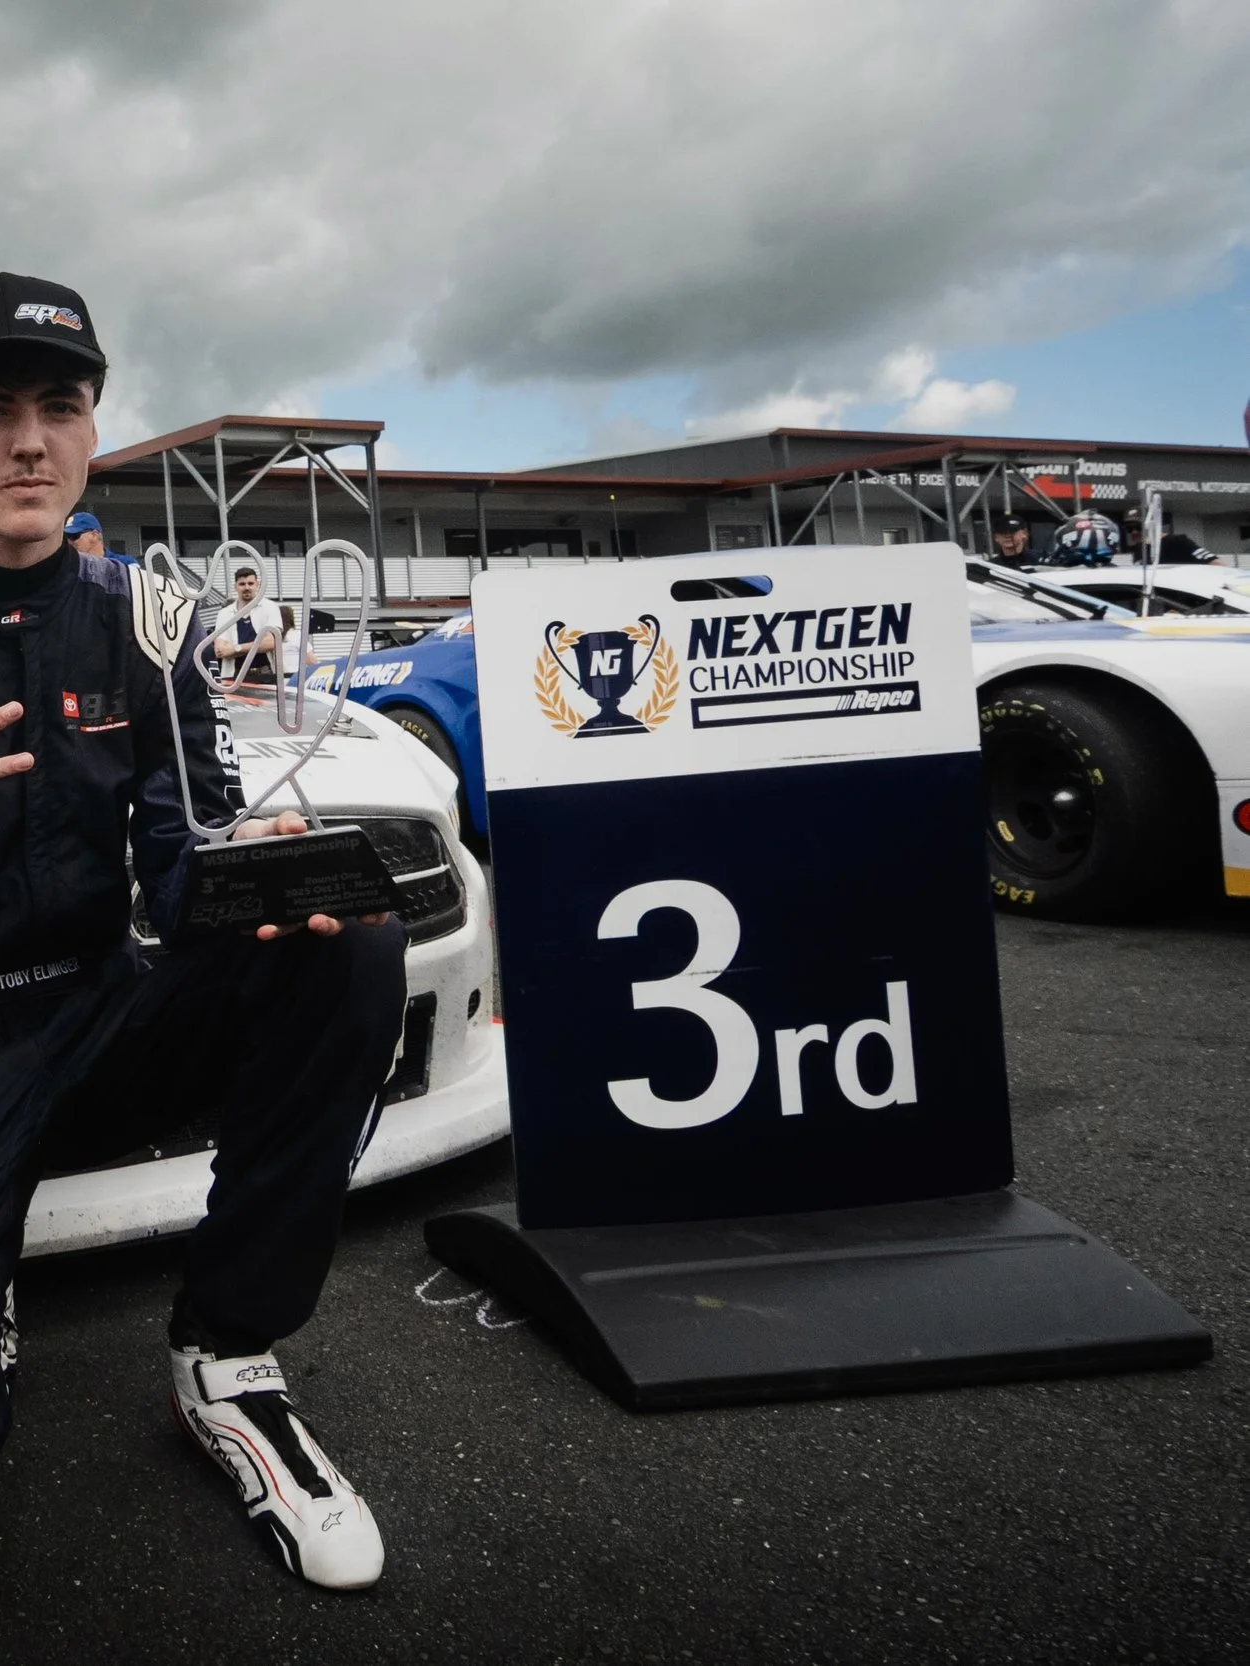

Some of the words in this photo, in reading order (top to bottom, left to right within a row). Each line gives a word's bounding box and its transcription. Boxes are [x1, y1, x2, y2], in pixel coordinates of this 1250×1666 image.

[686, 602, 913, 661] NEXTGEN
[589, 648, 625, 677] NG
[689, 651, 916, 693] CHAMPIONSHIP
[851, 688, 916, 711] Repco
[401, 719, 430, 741] EAGLE
[203, 851, 247, 867] MSNZ
[250, 837, 361, 861] Championship
[228, 882, 256, 892] Place
[304, 873, 338, 885] Round
[340, 872, 362, 881] One
[284, 887, 311, 898] 2025
[313, 884, 332, 894] Oct
[32, 957, 81, 981] ELMIGER
[597, 879, 918, 1129] 3rd
